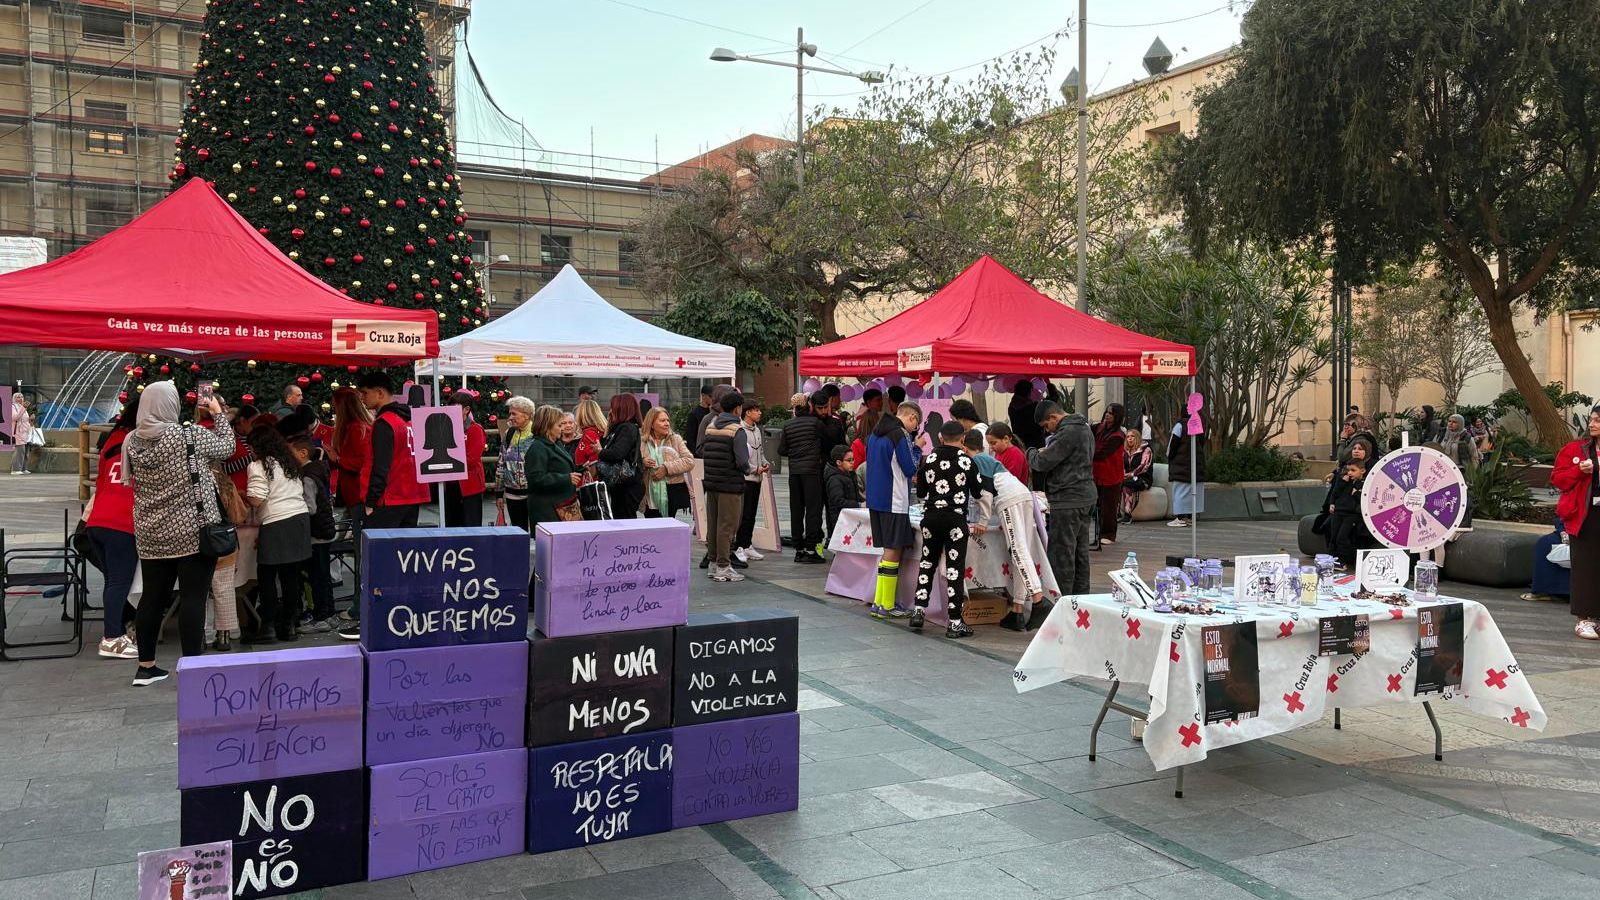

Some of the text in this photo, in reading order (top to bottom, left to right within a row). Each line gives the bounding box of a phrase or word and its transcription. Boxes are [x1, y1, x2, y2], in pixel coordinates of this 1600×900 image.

[107, 317, 323, 341] Cada vez más cerca de las personas
[369, 331, 421, 347] Cruz Roja
[1029, 356, 1044, 365] Cada
[1058, 358, 1071, 366] más
[1098, 359, 1108, 367] las
[1109, 360, 1134, 368] personas
[1159, 358, 1187, 368] Cruz Roja
[188, 454, 197, 473] BIMBA
[579, 534, 662, 564] Ni sumisa
[397, 547, 476, 574] VIVAS
[582, 565, 596, 577] ni
[1368, 555, 1394, 576] 25N
[442, 577, 500, 604] NOS
[584, 573, 676, 602] te quiero libre
[387, 602, 516, 640] QUEREMOS
[582, 600, 616, 620] linda
[1420, 611, 1431, 624] ESTO
[1206, 630, 1220, 644] ESTO
[1428, 624, 1433, 636] ES
[690, 637, 777, 659] DIGAMOS
[1216, 644, 1223, 659] ES
[1420, 636, 1438, 648] NORMAL
[614, 645, 658, 679] UNA
[1207, 658, 1230, 674] NORMAL
[1294, 654, 1318, 691] Cruz Roja
[1336, 660, 1356, 676] Cruz
[1400, 657, 1414, 674] Cruz
[385, 658, 472, 690] Por las
[688, 669, 777, 690] NO A LA
[204, 671, 341, 717] ROMPAMOS
[690, 692, 787, 714] VIOLENCIA
[480, 699, 502, 718] que
[568, 697, 650, 734] MENOS
[256, 714, 288, 734] EL
[376, 732, 396, 742] un
[476, 731, 505, 752] NO
[706, 730, 732, 764] NO
[550, 744, 672, 788] RESPETALA
[414, 794, 437, 812] EL
[572, 783, 640, 814] NO ES
[238, 784, 315, 836] NO
[416, 807, 515, 838] DE LAS QUE
[576, 808, 632, 843] TUYA
[258, 838, 293, 865] es
[418, 822, 504, 868] NO ESTAN
[234, 858, 298, 896] NO
